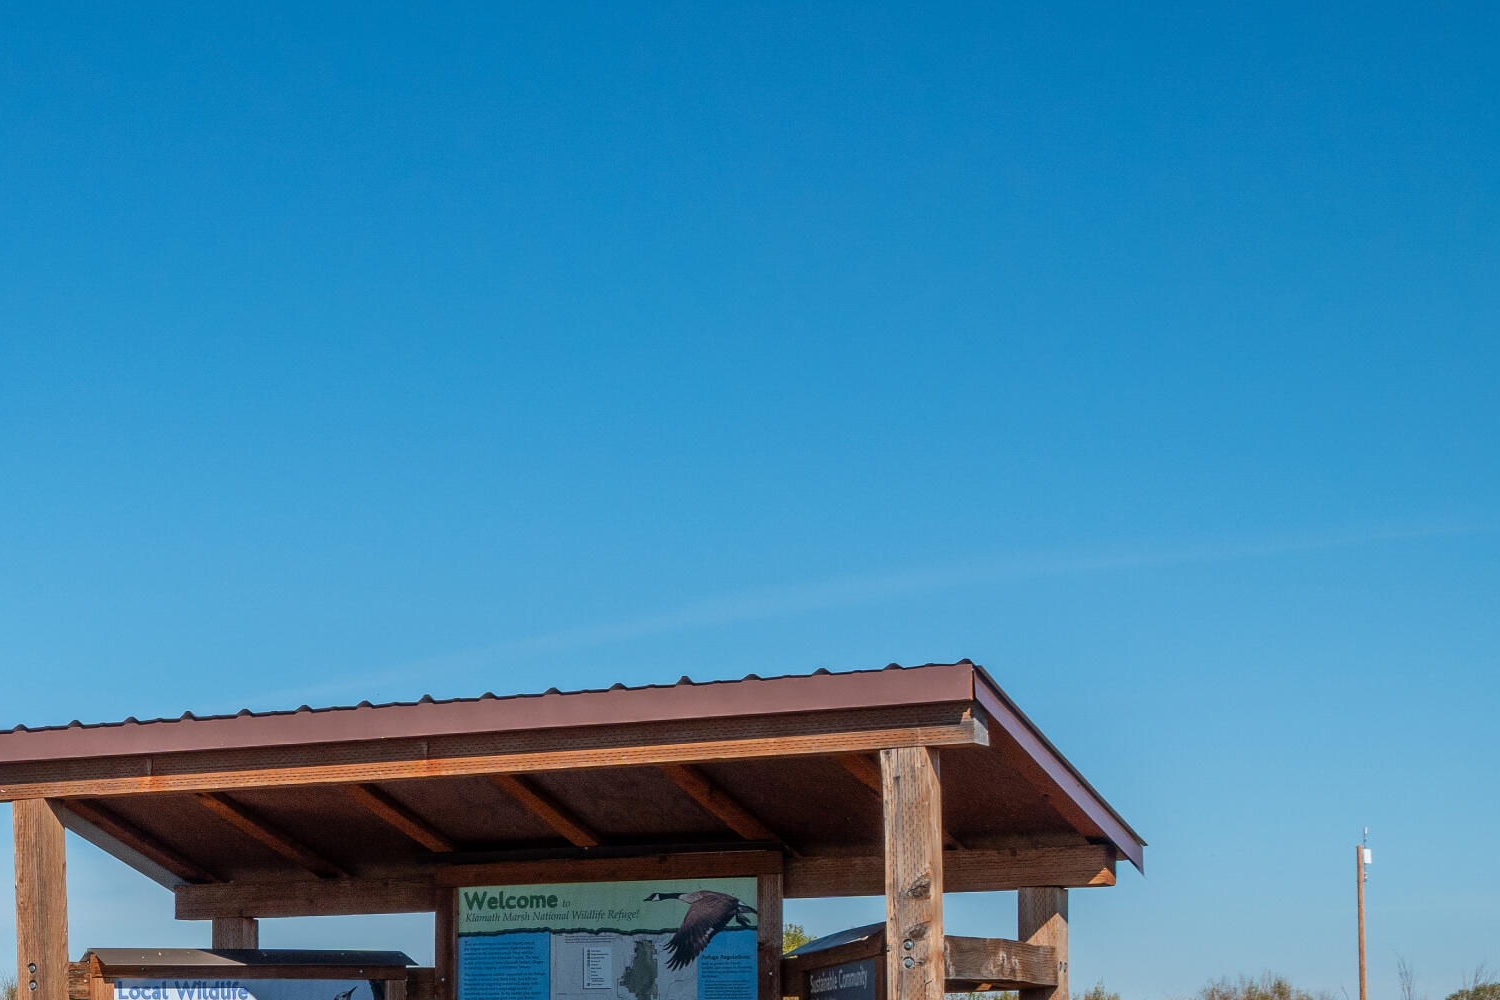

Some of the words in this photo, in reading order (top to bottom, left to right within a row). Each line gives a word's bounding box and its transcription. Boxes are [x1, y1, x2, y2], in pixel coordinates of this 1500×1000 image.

[463, 890, 559, 911] Welcome
[562, 899, 571, 908] to
[465, 912, 501, 923] Klamath
[502, 910, 530, 922] Marsh
[532, 910, 570, 922] National
[571, 909, 606, 922] Wildlife
[607, 909, 640, 922] Refuge!
[118, 980, 169, 1000] Local
[174, 980, 249, 1000] Wildlife
